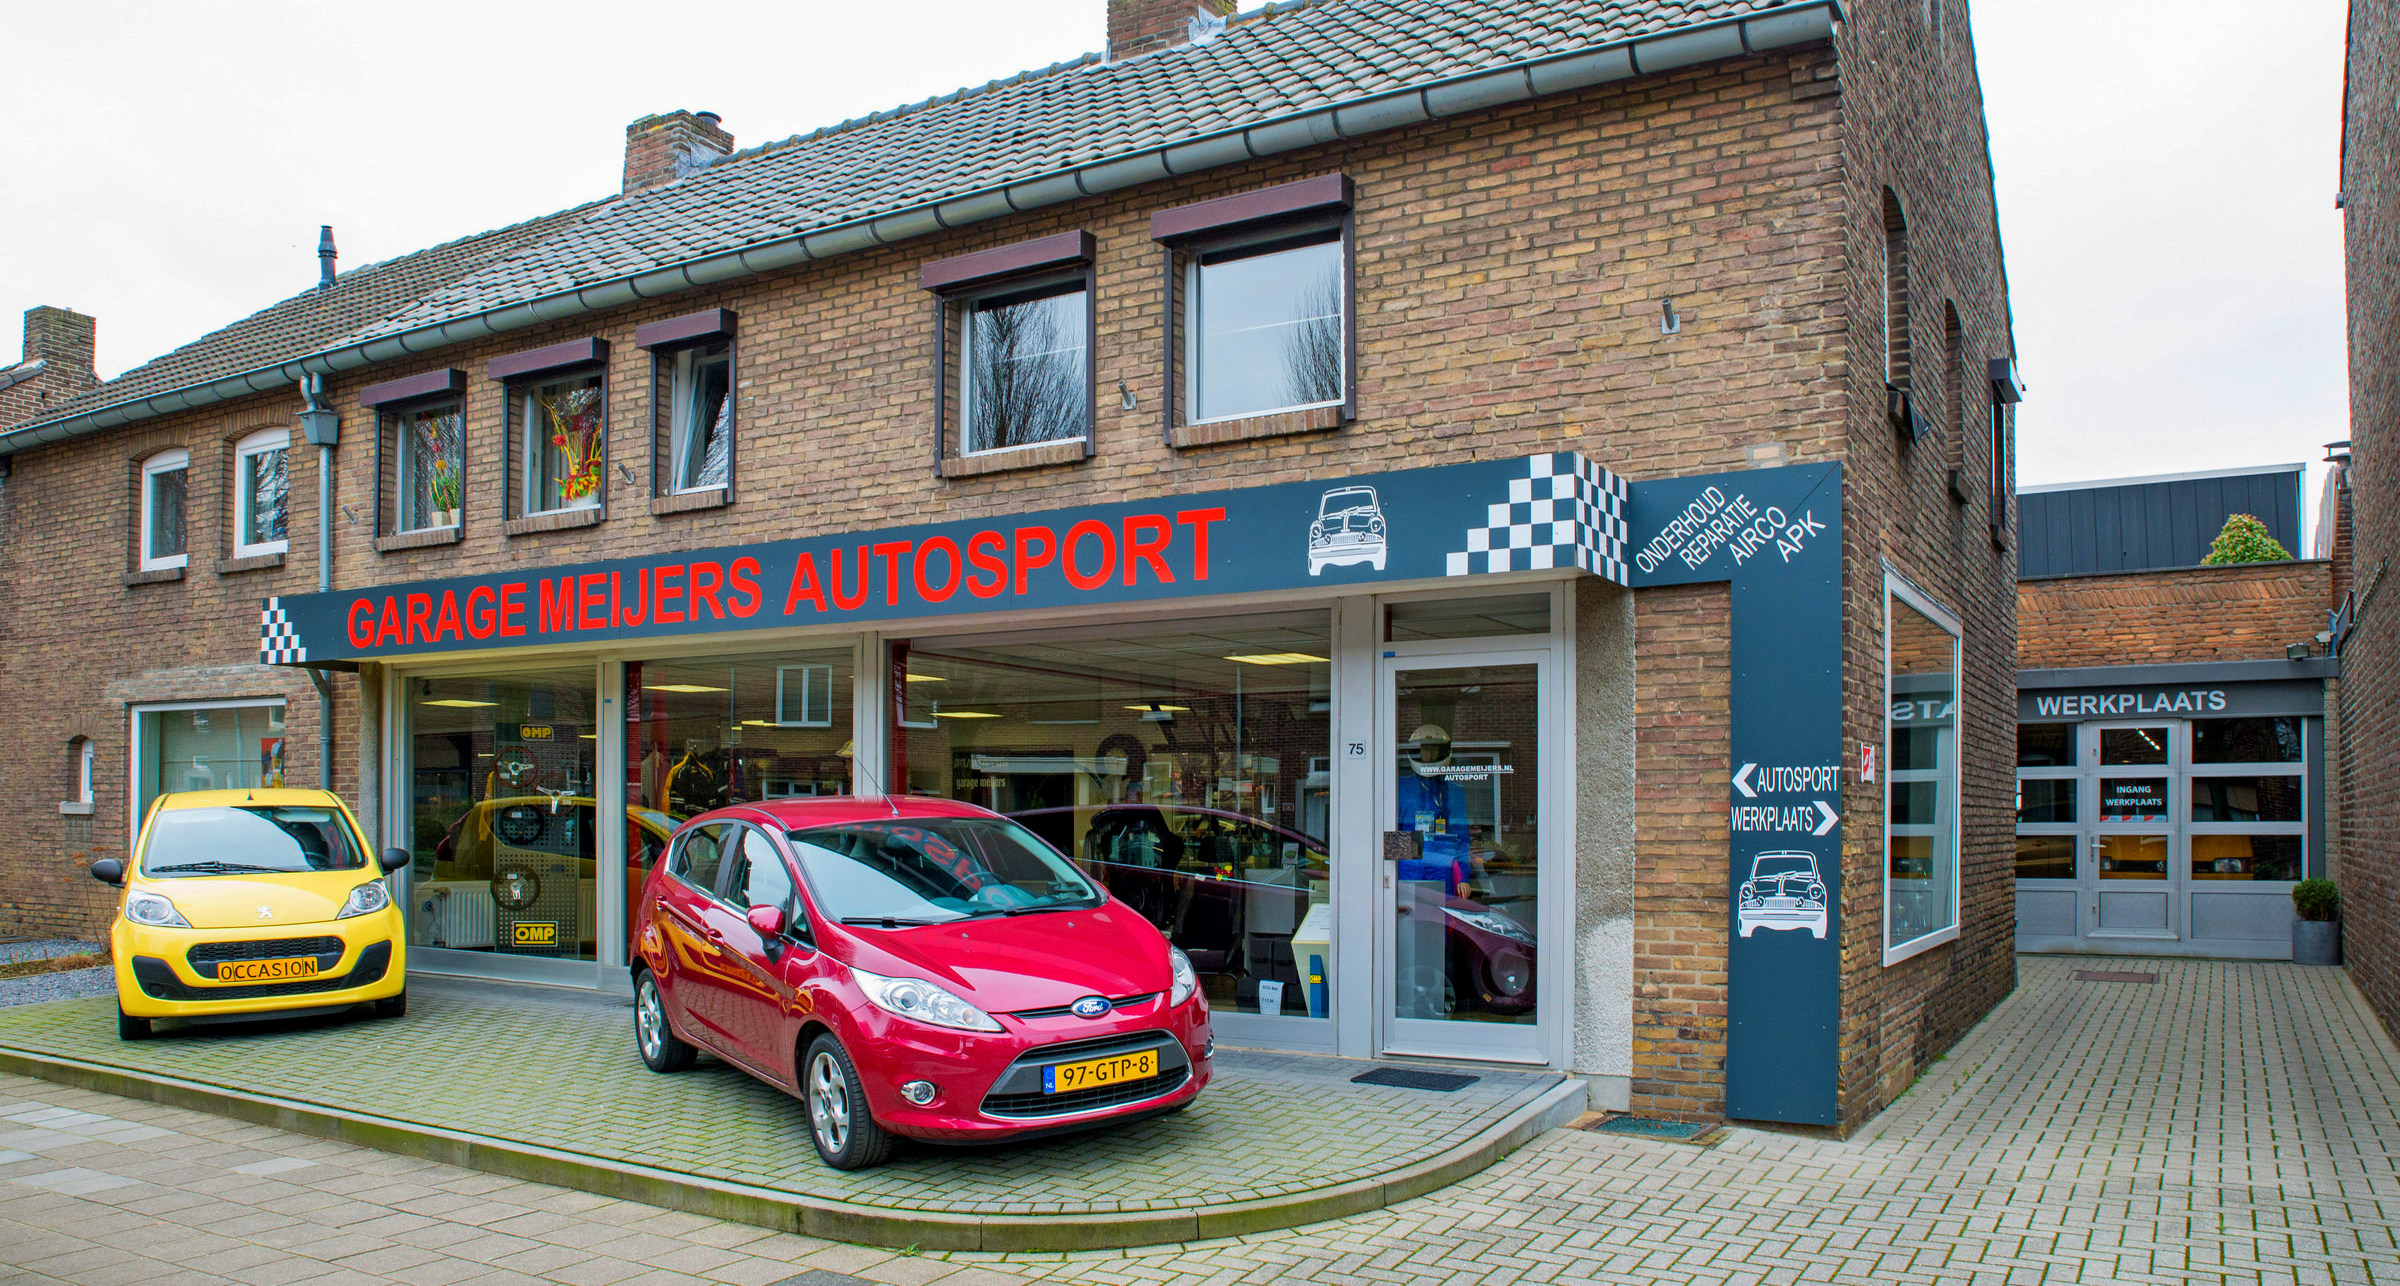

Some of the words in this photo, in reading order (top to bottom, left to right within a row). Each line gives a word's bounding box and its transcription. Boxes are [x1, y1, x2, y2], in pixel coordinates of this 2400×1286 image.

[1635, 486, 1725, 573] ONDERHOUD
[1679, 493, 1758, 571] REPARATIE
[1728, 506, 1787, 566] AIRCO
[1776, 509, 1826, 563] APK
[347, 582, 527, 649] GARAGE
[538, 556, 763, 633] MEIJERS
[783, 506, 1227, 615] AUTOSPORT
[2036, 690, 2227, 716] WERKPLAATS
[1348, 742, 1364, 755] 75
[1420, 764, 1515, 773] WWW.GARAGEMEIJERS.NL
[1444, 774, 1489, 782] AUTOSPORT
[1757, 765, 1840, 793] AUTOSPORT
[2105, 798, 2163, 806] WERKPLAATS
[2116, 785, 2152, 794] INGANG
[1731, 806, 1814, 832] WERKPLAATS
[515, 927, 555, 941] OMP
[221, 960, 315, 980] OCCASION
[1082, 1000, 1104, 1013] Ford
[1063, 1055, 1149, 1087] 97-GTP-8
